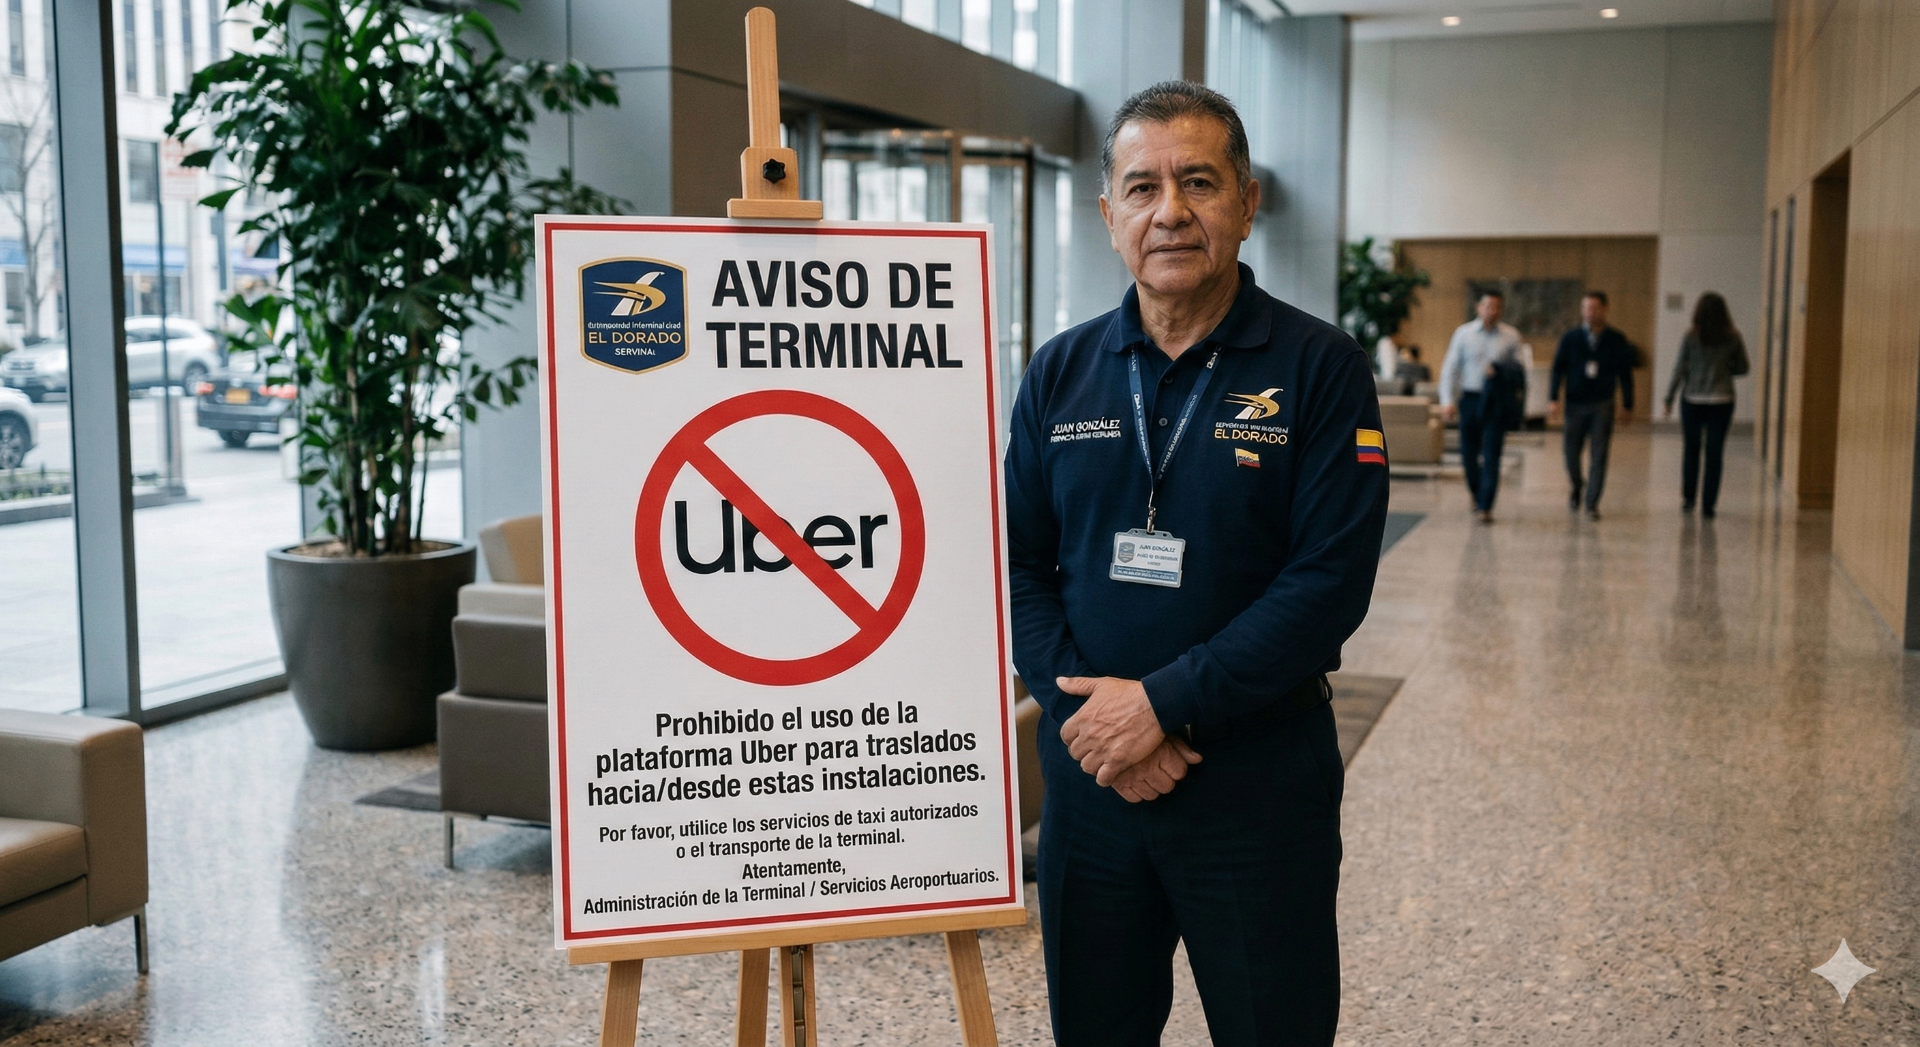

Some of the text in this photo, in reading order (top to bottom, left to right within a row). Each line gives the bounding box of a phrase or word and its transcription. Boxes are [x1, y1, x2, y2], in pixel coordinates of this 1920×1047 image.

[711, 259, 954, 309] AVISO DE
[588, 331, 682, 344] EL DORADO
[705, 321, 964, 369] TERMINAL
[1052, 416, 1121, 435] JUAN GONZÁLEZ
[1214, 428, 1288, 445] EL DORADO
[674, 498, 889, 575] Uber
[656, 700, 918, 738] Prohibido el uso de la
[596, 728, 977, 779] plataforma Uber para traslados
[586, 761, 986, 807] hacia/desde estas instalaciones.
[599, 802, 979, 843] Por favor, utilice los servicios de taxi autorizados
[676, 827, 905, 859] o el transporte de la terminal.
[741, 858, 846, 880] Atentamente,
[583, 867, 1000, 915] Administración de la Terminal / Servicios Aeroportuarios.
